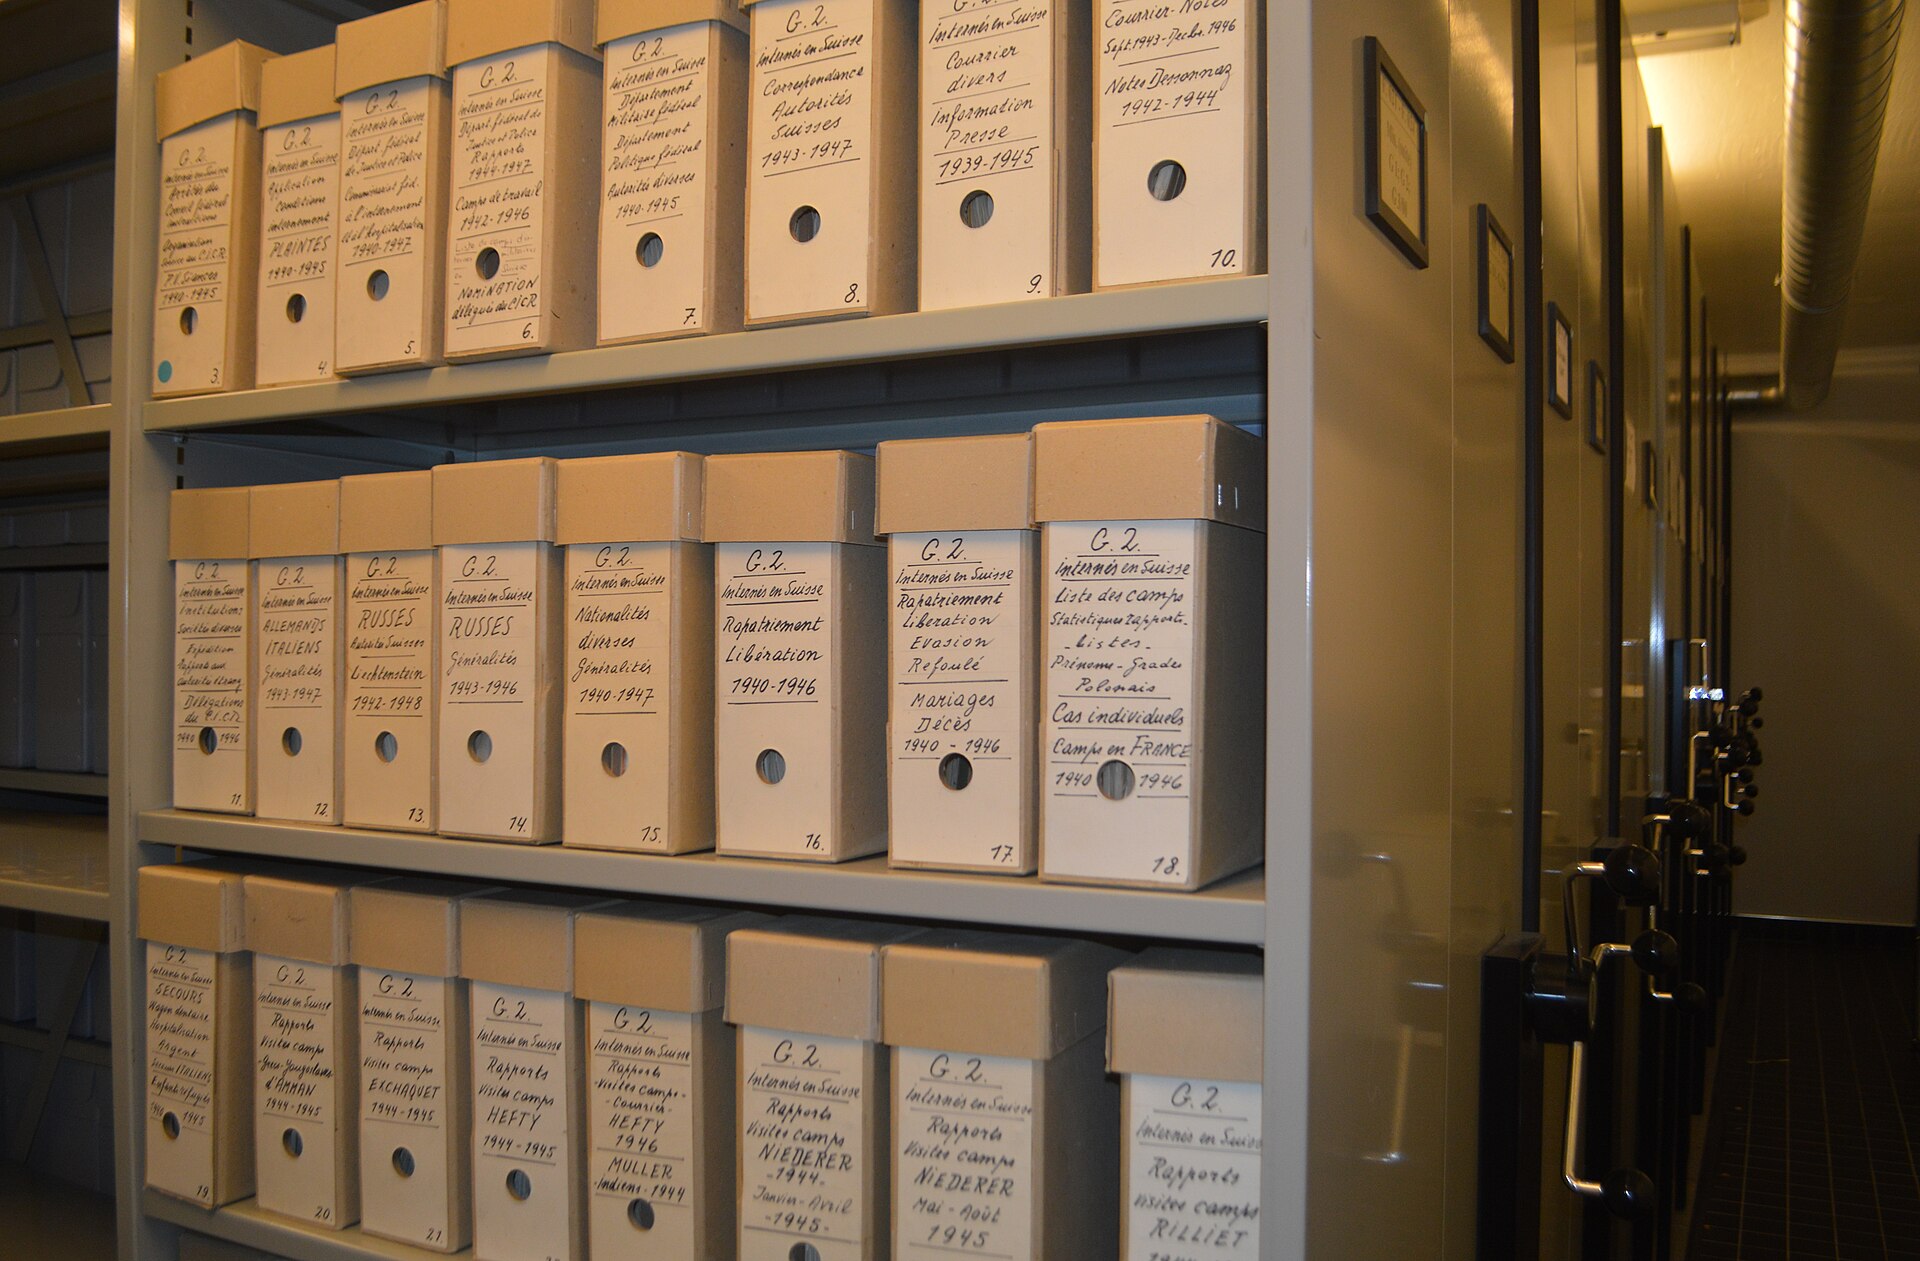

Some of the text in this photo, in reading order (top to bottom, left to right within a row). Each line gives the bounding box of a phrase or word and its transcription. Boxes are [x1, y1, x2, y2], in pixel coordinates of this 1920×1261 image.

[946, 46, 1019, 70] Courrier
[763, 66, 864, 97] Correspondance
[946, 70, 1007, 93] divers
[1105, 77, 1145, 94] Notes
[772, 90, 853, 121] Autorités
[1123, 90, 1218, 117] 1942-1944
[944, 125, 1009, 149] Presse
[762, 139, 852, 168] 1943-1947
[939, 146, 1040, 178] 1939-1945
[616, 196, 680, 219] 1940-1945
[1211, 249, 1236, 268] 10.
[844, 283, 860, 304] 8.
[1027, 274, 1042, 294] 9.
[683, 308, 697, 325] 7.
[522, 323, 534, 339] 6.
[404, 340, 415, 355] 5.
[210, 368, 220, 384] 3.
[897, 592, 1003, 615] Rapatriement
[1055, 587, 1184, 610] Liste des camps
[358, 608, 416, 630] RUSSES
[575, 604, 650, 623] Nationalités
[263, 618, 326, 634] ALLEMANDS
[449, 616, 514, 639] RUSSES
[723, 616, 824, 640] Rapatriement
[265, 640, 322, 655] ITALIENS
[579, 631, 635, 650] diverses
[910, 636, 995, 650] Evasion
[447, 650, 517, 676] Généralités
[726, 644, 823, 663] Libération
[572, 658, 651, 682] Généralités
[908, 656, 984, 679] Refoulé
[266, 688, 322, 703] 1943-1947
[450, 680, 517, 695] 1943-1946
[732, 677, 817, 695] 1940-1946
[353, 696, 423, 710] 1942-1948
[580, 688, 654, 707] 1940-1947
[911, 692, 995, 716] Mariages
[1052, 702, 1184, 726] Cas individuels
[914, 716, 972, 734] Décès
[1107, 745, 1124, 756] en
[1130, 734, 1192, 758] FRANCE
[1056, 772, 1182, 790] 1940 1946
[232, 794, 241, 806] 11.
[314, 803, 328, 817] 12.
[409, 808, 424, 823] 13.
[509, 816, 526, 833] 14.
[641, 826, 662, 843] 15.
[805, 833, 825, 851] 16.
[991, 845, 1013, 863] 17.
[1152, 857, 1180, 876] 18.
[486, 1056, 548, 1081] Rapports
[608, 1060, 661, 1079] Rapports
[486, 1105, 541, 1132] HEFTY
[767, 1097, 831, 1124] Rapports
[608, 1114, 664, 1134] HEFTY
[927, 1115, 1003, 1144] Rapports
[616, 1135, 658, 1152] 1946
[793, 1128, 845, 1151] camps
[759, 1143, 852, 1171] NIEDERER
[608, 1157, 673, 1179] MULLER
[1149, 1156, 1240, 1190] Rapports
[914, 1166, 1014, 1197] NIEDERER
[928, 1225, 990, 1249] 1945
[1150, 1217, 1248, 1248] RILLIET
